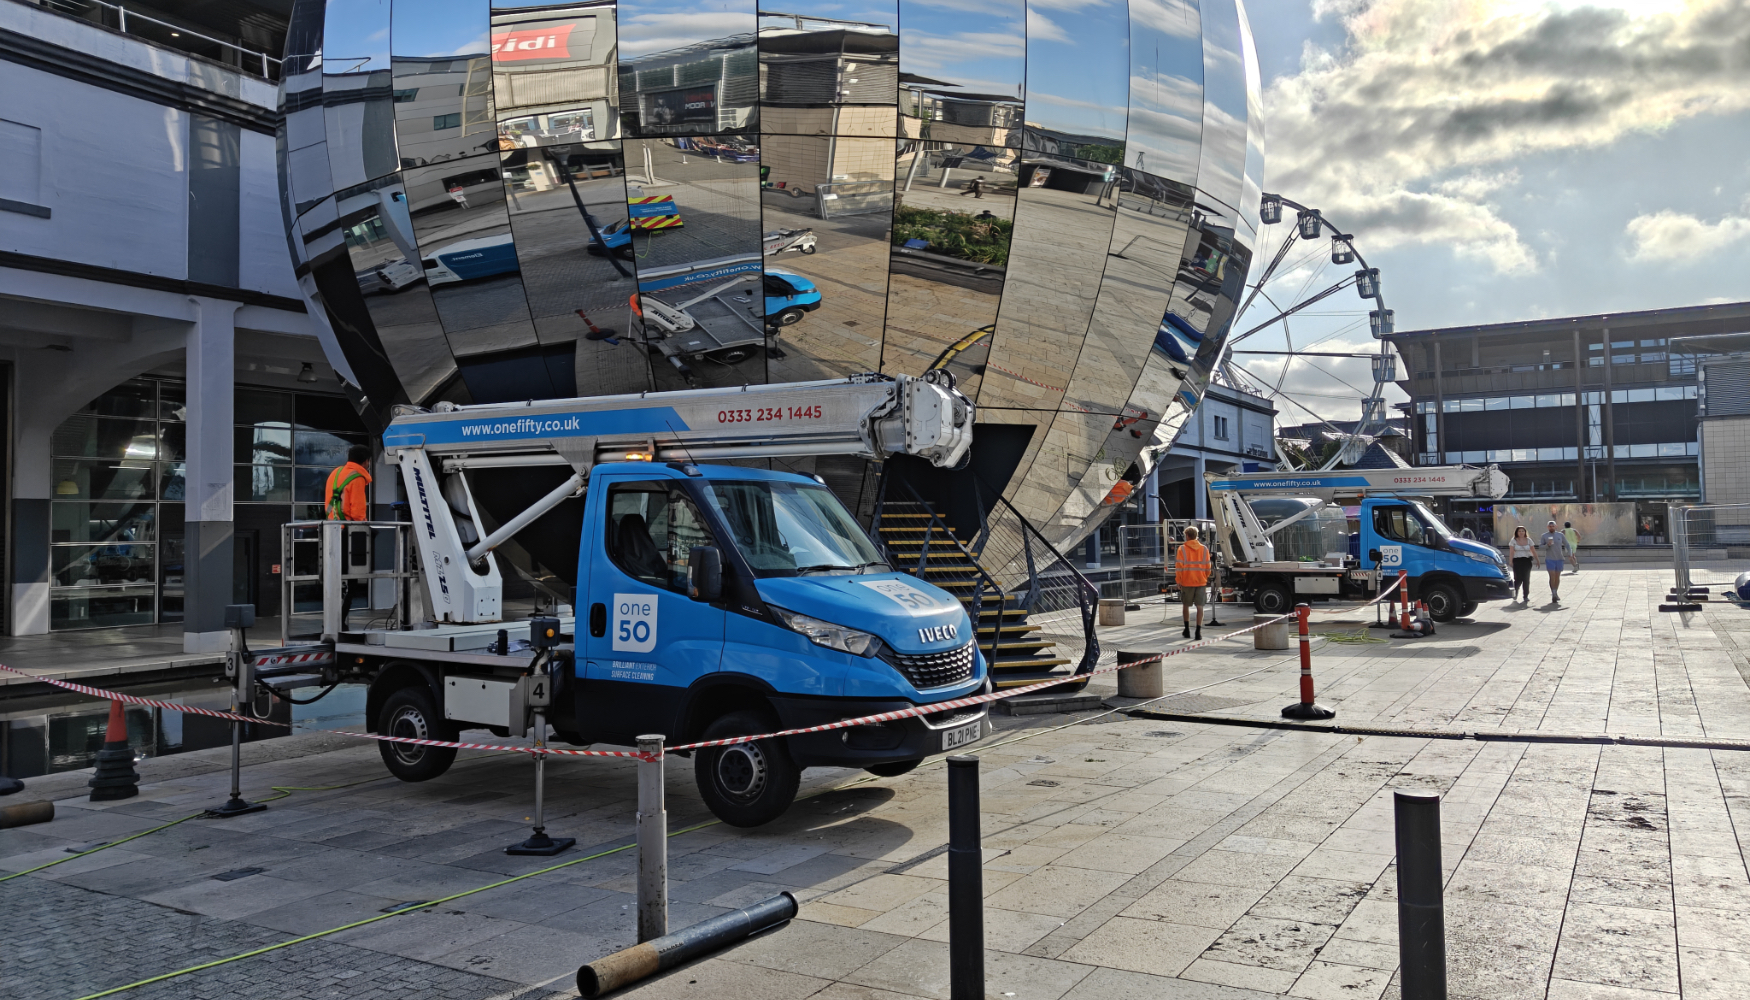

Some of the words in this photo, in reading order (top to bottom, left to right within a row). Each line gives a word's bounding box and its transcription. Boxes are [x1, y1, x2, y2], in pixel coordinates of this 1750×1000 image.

[718, 409, 752, 424] 0333
[756, 407, 783, 422] 234
[787, 405, 822, 420] 1445
[461, 416, 580, 436] www.onefifty.co.uk
[1253, 480, 1322, 488] www.onefifty.co.uk
[413, 467, 436, 540] MULTITEL
[1383, 554, 1399, 563] 50
[876, 583, 910, 593] one
[620, 602, 651, 617] one
[894, 592, 935, 610] 50
[618, 620, 651, 643] 50
[918, 623, 958, 645] IVECO
[227, 657, 234, 672] 3
[532, 682, 545, 700] 4
